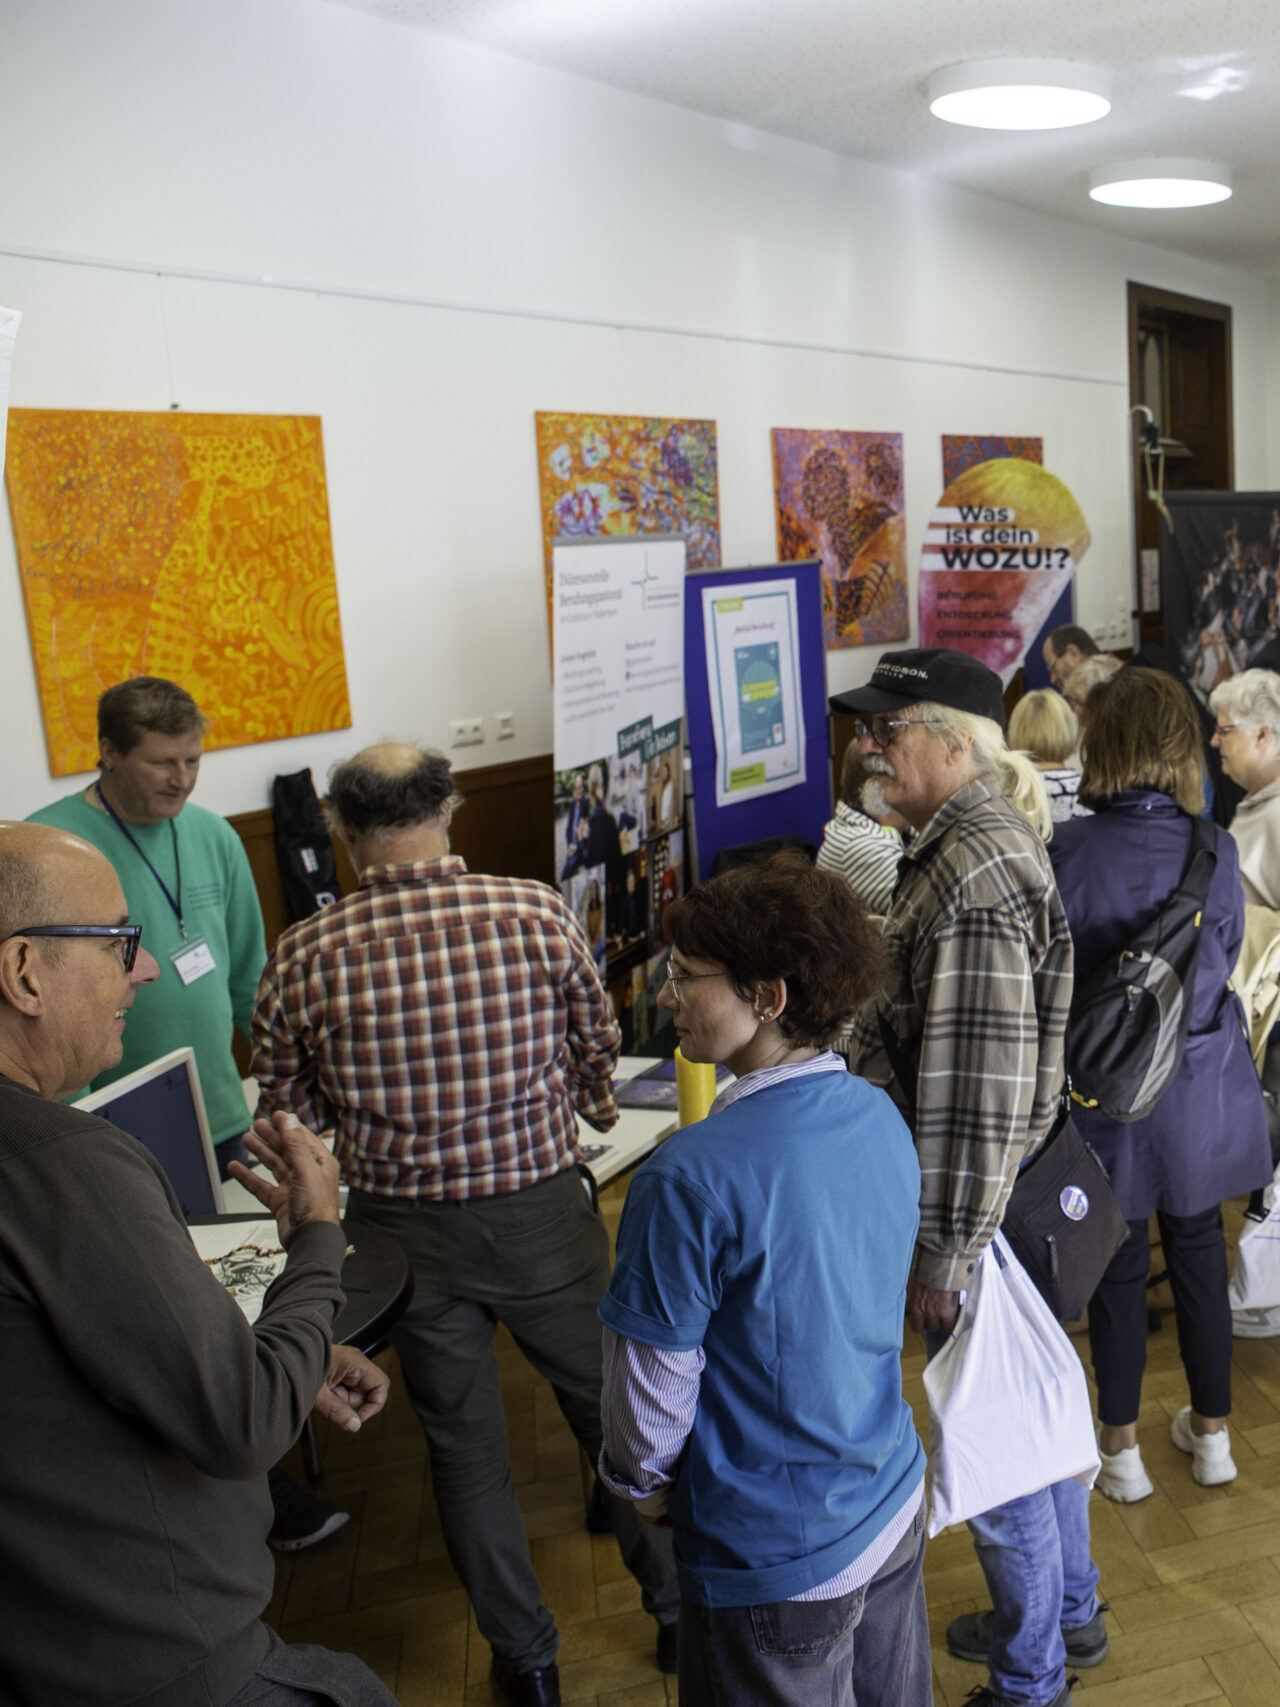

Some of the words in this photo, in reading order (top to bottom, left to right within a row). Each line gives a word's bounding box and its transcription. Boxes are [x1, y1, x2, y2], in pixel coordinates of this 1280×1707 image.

[958, 505, 1009, 522] Was
[946, 525, 973, 544] ist
[981, 525, 1033, 544] dein
[941, 548, 1070, 569] WOZU!?
[937, 591, 998, 600] BERUFUNG
[937, 610, 1013, 619] ENTDECKUNG
[937, 630, 1020, 639] ORIENTIERUNG
